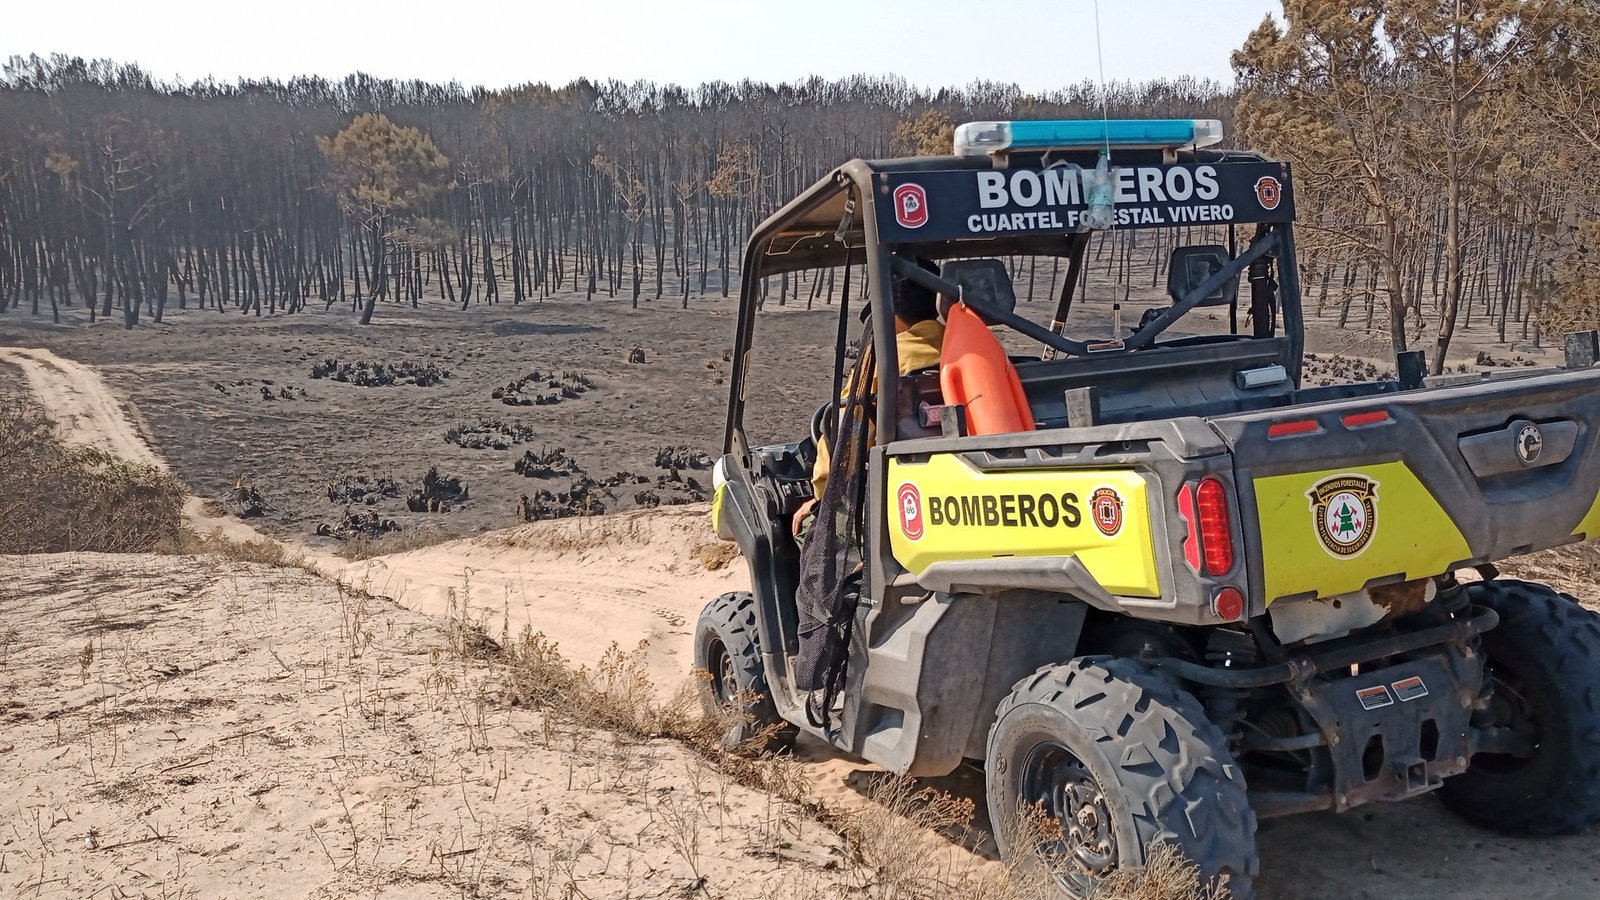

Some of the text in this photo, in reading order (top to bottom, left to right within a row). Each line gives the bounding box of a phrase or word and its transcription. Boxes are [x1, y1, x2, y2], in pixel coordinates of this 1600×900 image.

[967, 211, 1063, 233] CUARTEL
[1166, 203, 1234, 223] VIVERO
[928, 492, 1082, 529] BOMBEROS
